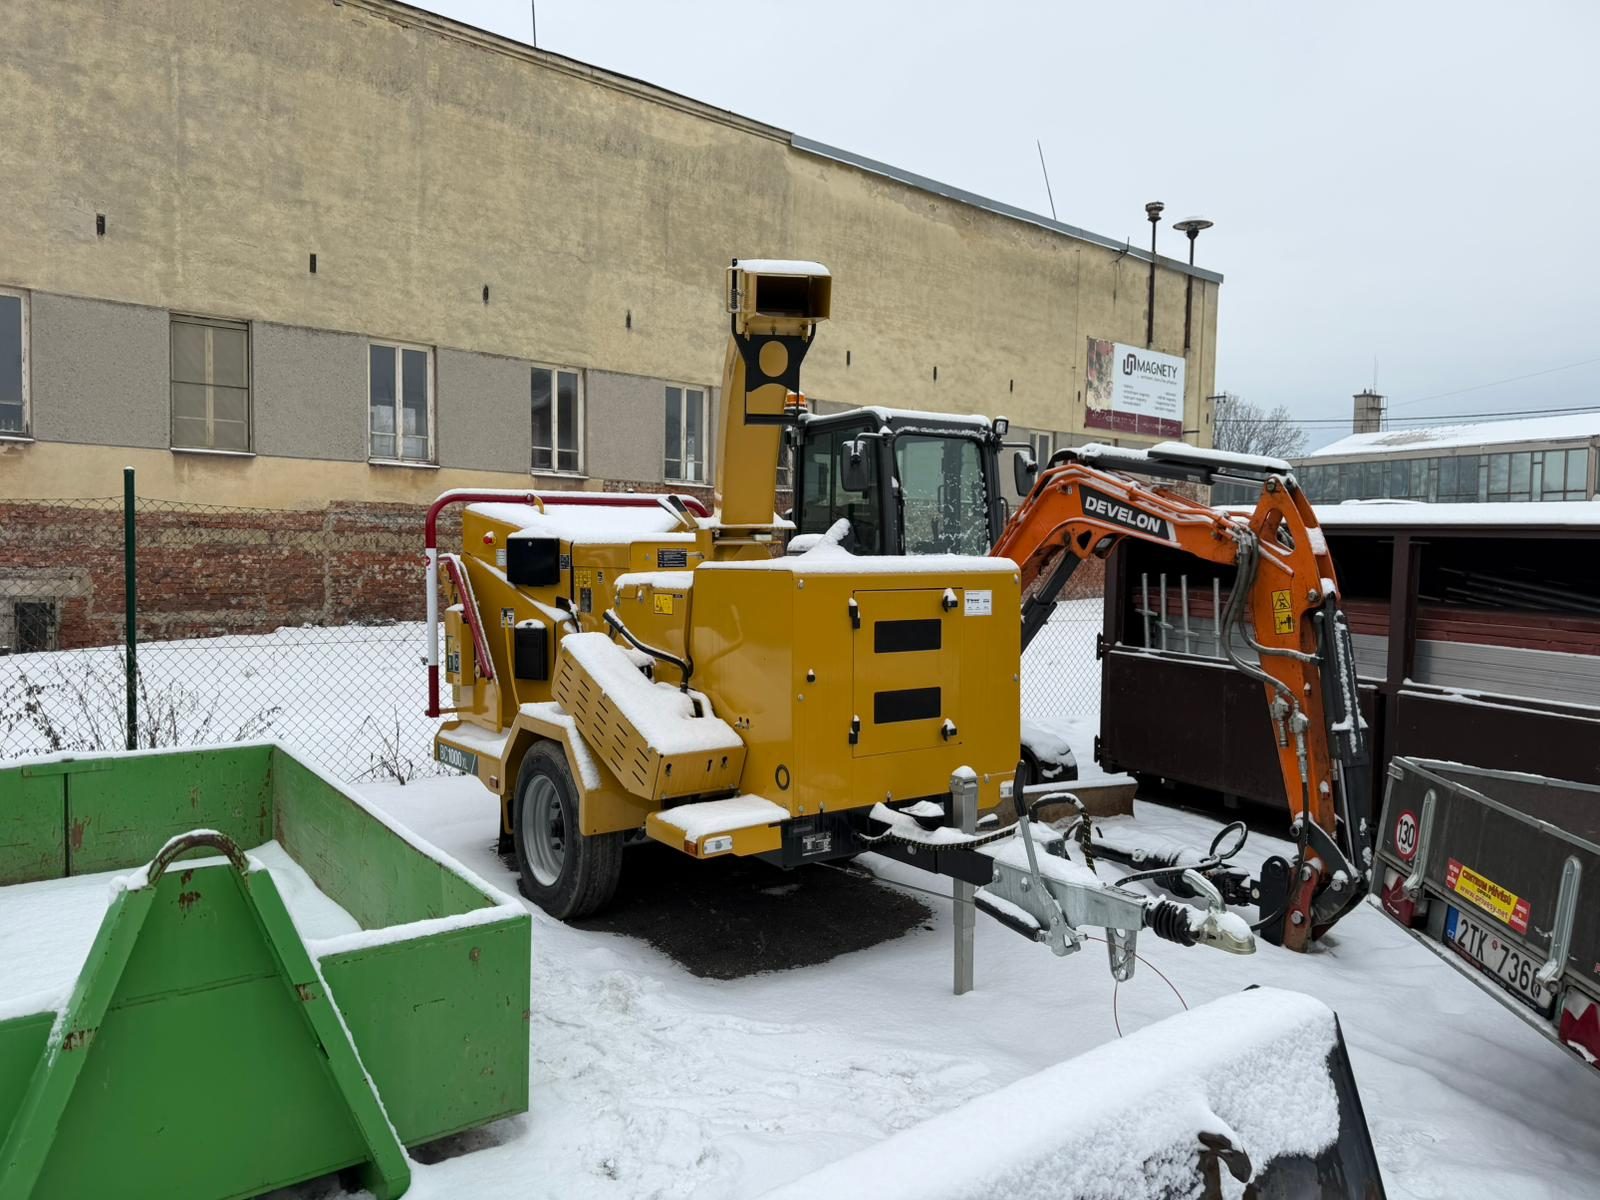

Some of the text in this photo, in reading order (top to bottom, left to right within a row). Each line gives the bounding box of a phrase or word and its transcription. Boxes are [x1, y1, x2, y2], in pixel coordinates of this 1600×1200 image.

[1136, 358, 1178, 379] MAGNETY
[1085, 495, 1161, 534] DEVELON
[1398, 819, 1415, 848] 130
[1459, 885, 1509, 919] www.privesy.net
[1457, 919, 1489, 962] 2TK
